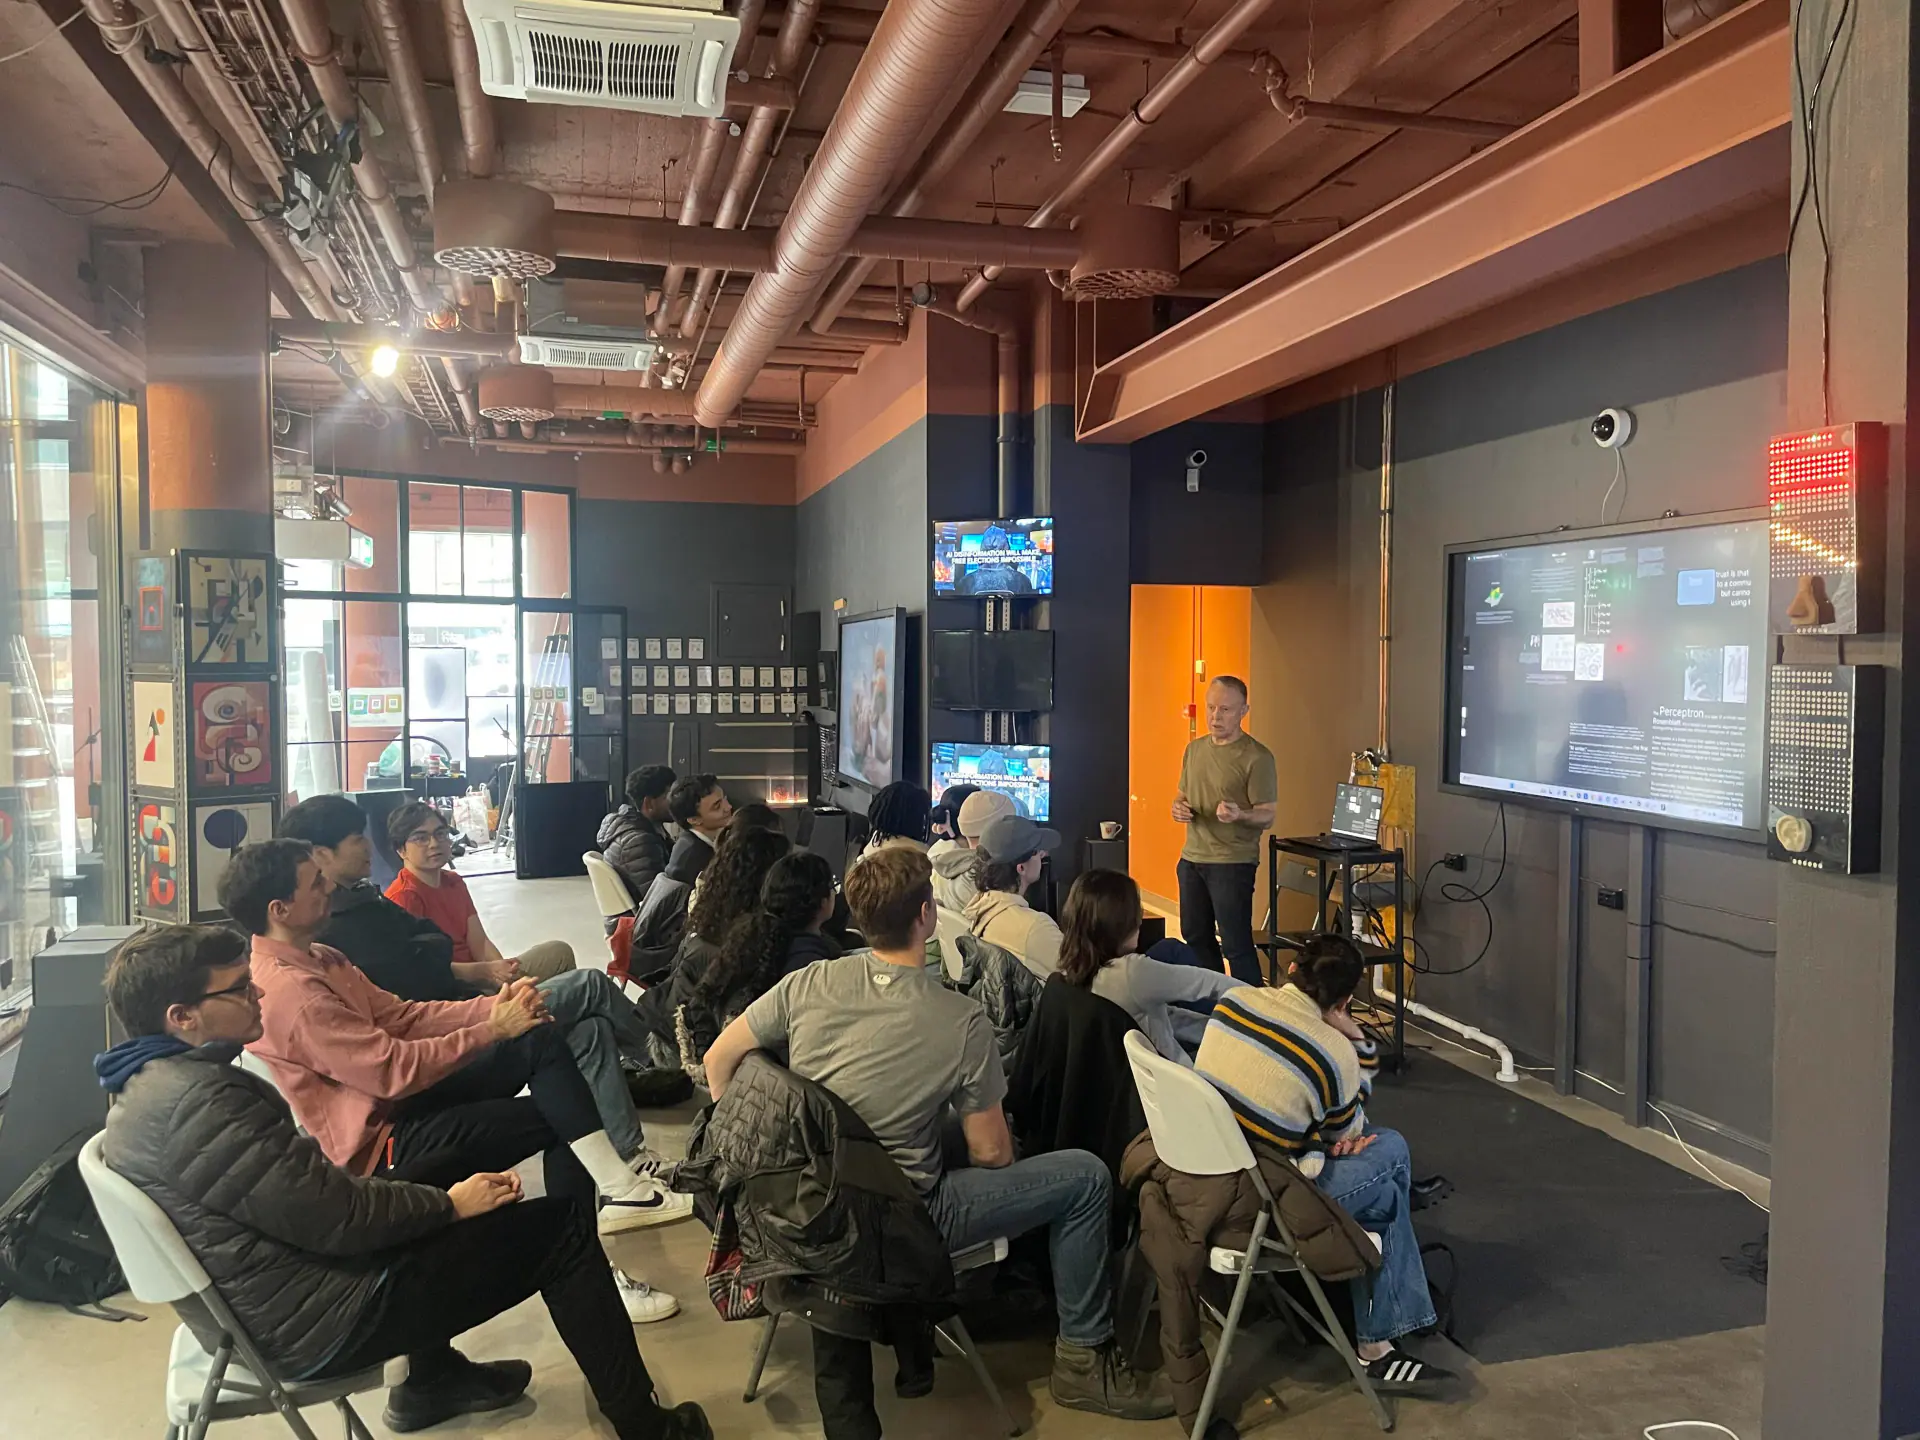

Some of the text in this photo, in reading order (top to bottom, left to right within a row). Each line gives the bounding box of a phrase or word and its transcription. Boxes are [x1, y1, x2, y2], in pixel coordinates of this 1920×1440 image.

[954, 549, 1006, 558] DISINFORMATION
[1737, 569, 1749, 577] that
[1731, 599, 1747, 608] using
[1659, 706, 1704, 719] Perceptron
